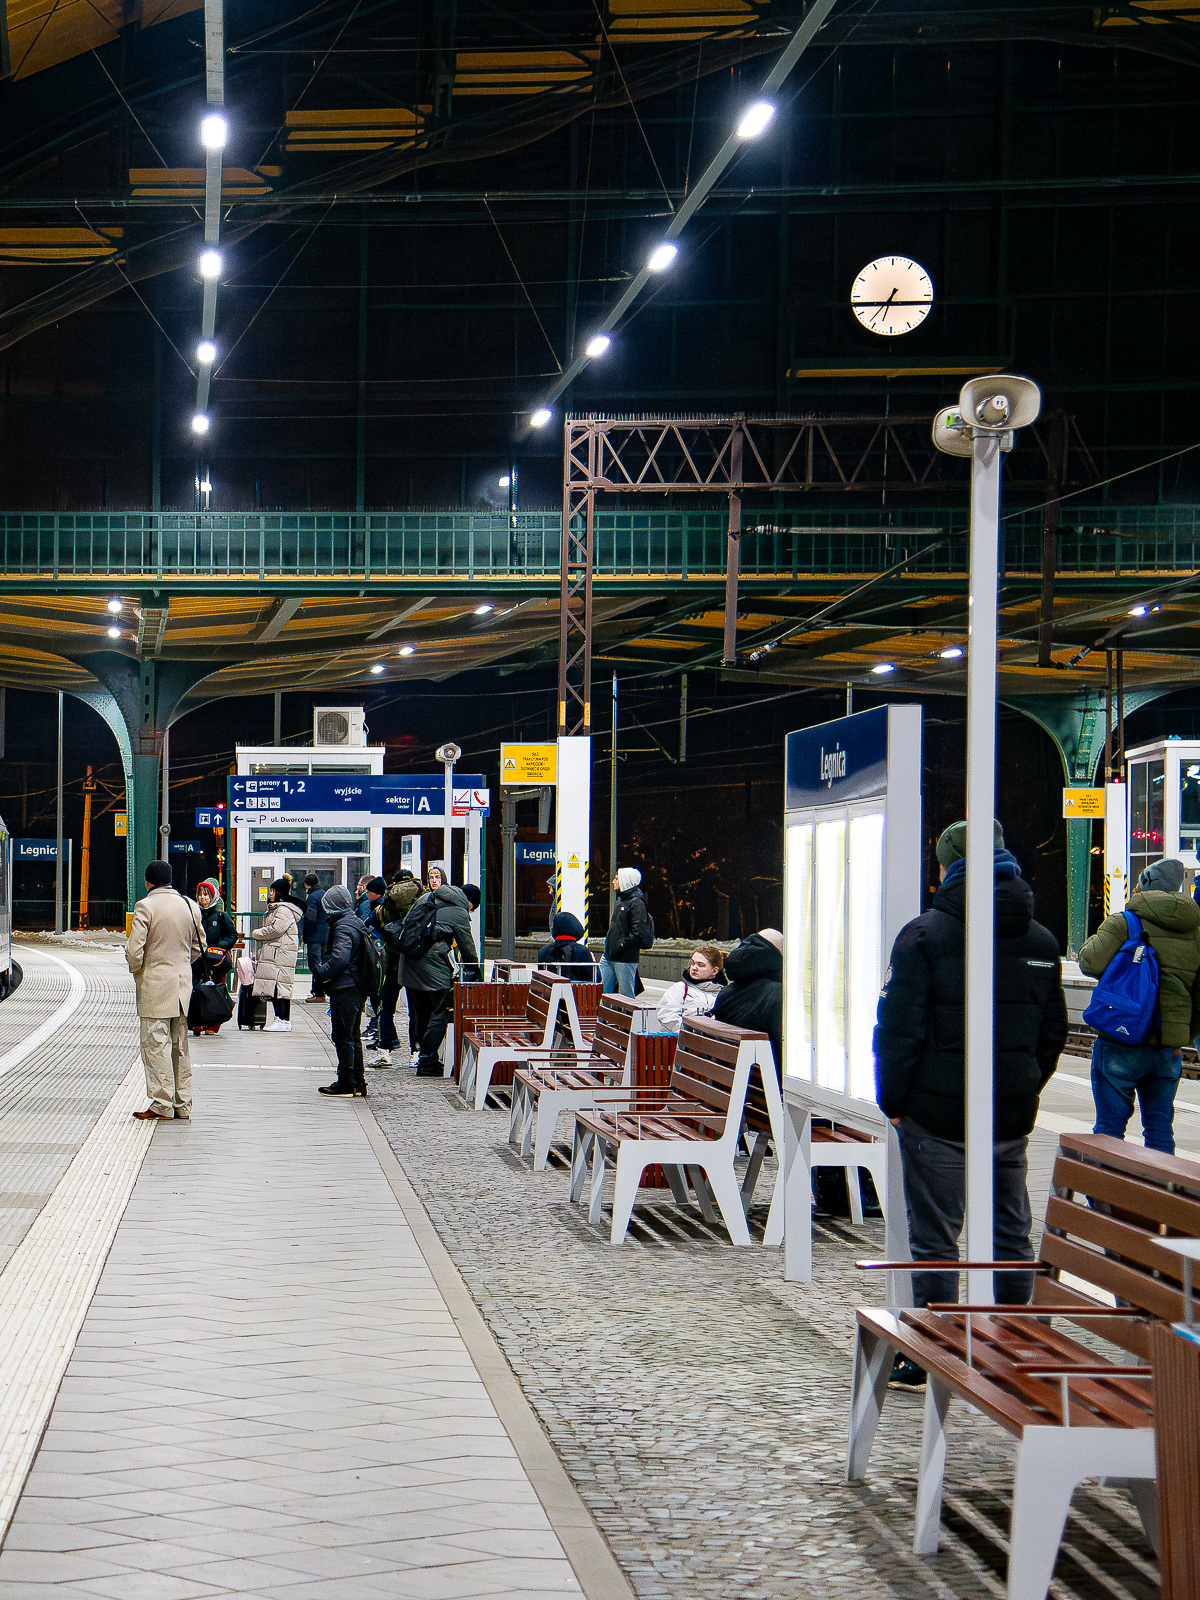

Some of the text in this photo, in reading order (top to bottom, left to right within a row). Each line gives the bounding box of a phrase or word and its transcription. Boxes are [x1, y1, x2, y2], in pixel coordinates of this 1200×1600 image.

[820, 741, 846, 789] Legnica
[296, 780, 306, 792] 2
[334, 787, 362, 796] wyjście
[385, 796, 431, 812] sektor A
[523, 848, 557, 861] Legnic
